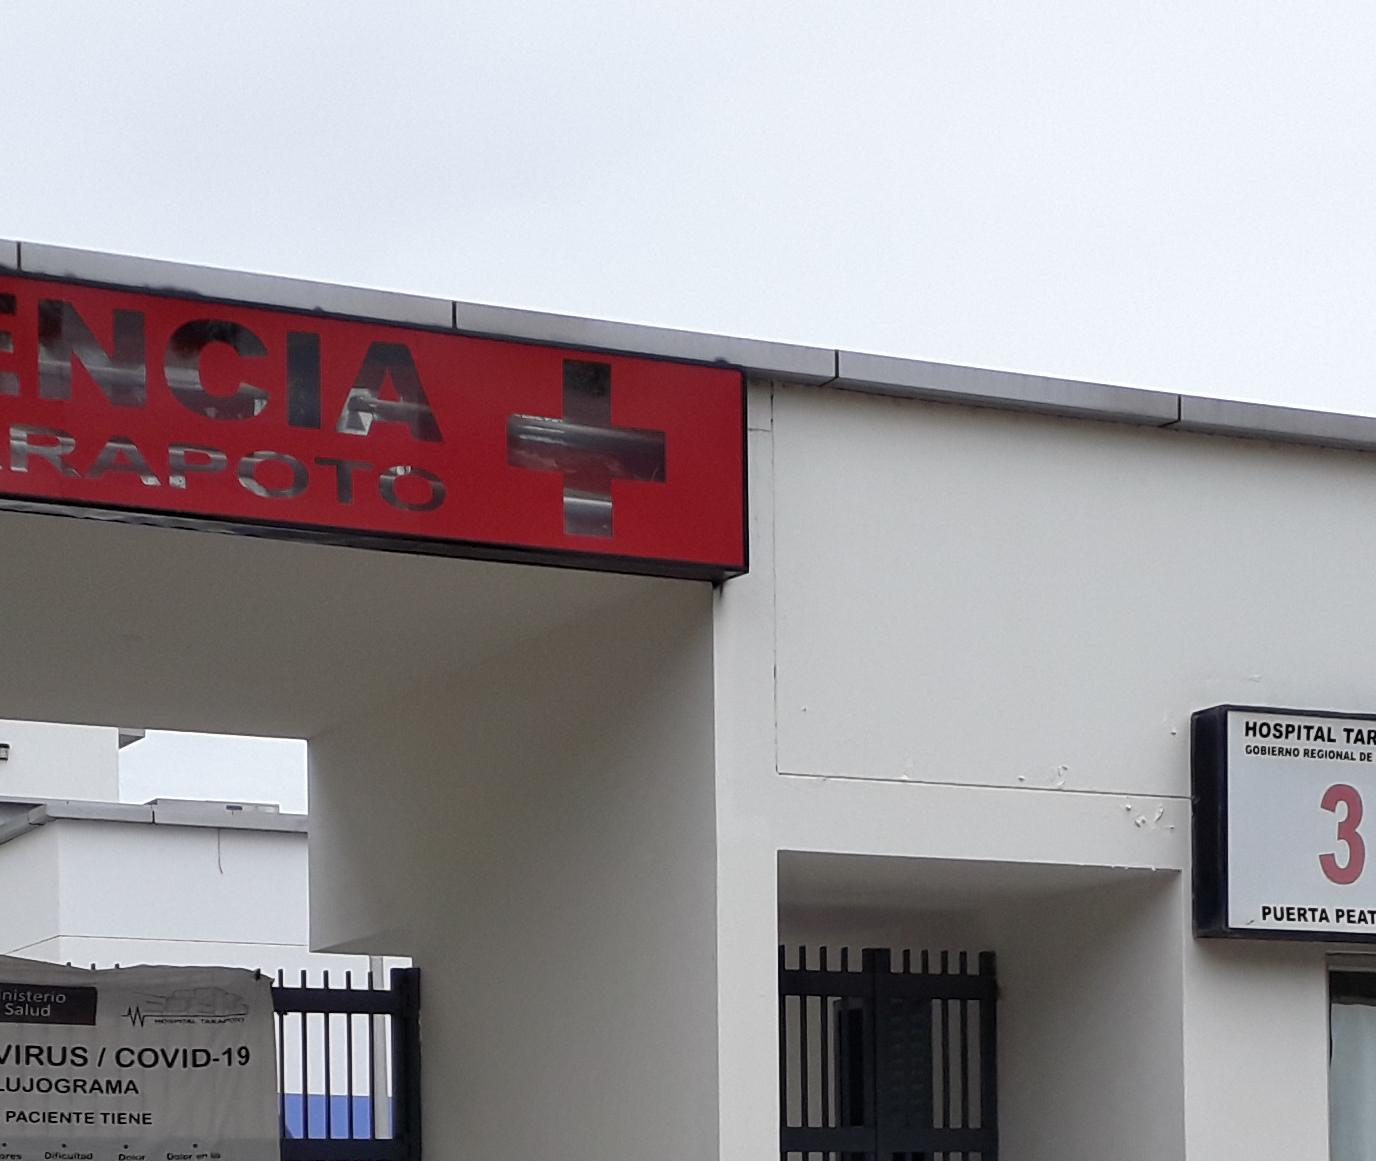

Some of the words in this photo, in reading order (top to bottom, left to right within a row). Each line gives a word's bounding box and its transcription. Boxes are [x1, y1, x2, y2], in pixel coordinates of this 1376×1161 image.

[1245, 721, 1336, 742] HOSPITAL
[1246, 745, 1299, 757] GOBIERNO
[1304, 749, 1356, 761] REGIONAL
[1360, 752, 1372, 762] DE
[1318, 783, 1366, 886] 3
[1262, 906, 1329, 922] PUERTA
[3, 1003, 51, 1018] Salud
[98, 1048, 106, 1067] /
[115, 1046, 250, 1068] COVID-19
[6, 1111, 94, 1124] PACIENTE
[100, 1113, 152, 1124] TIENE
